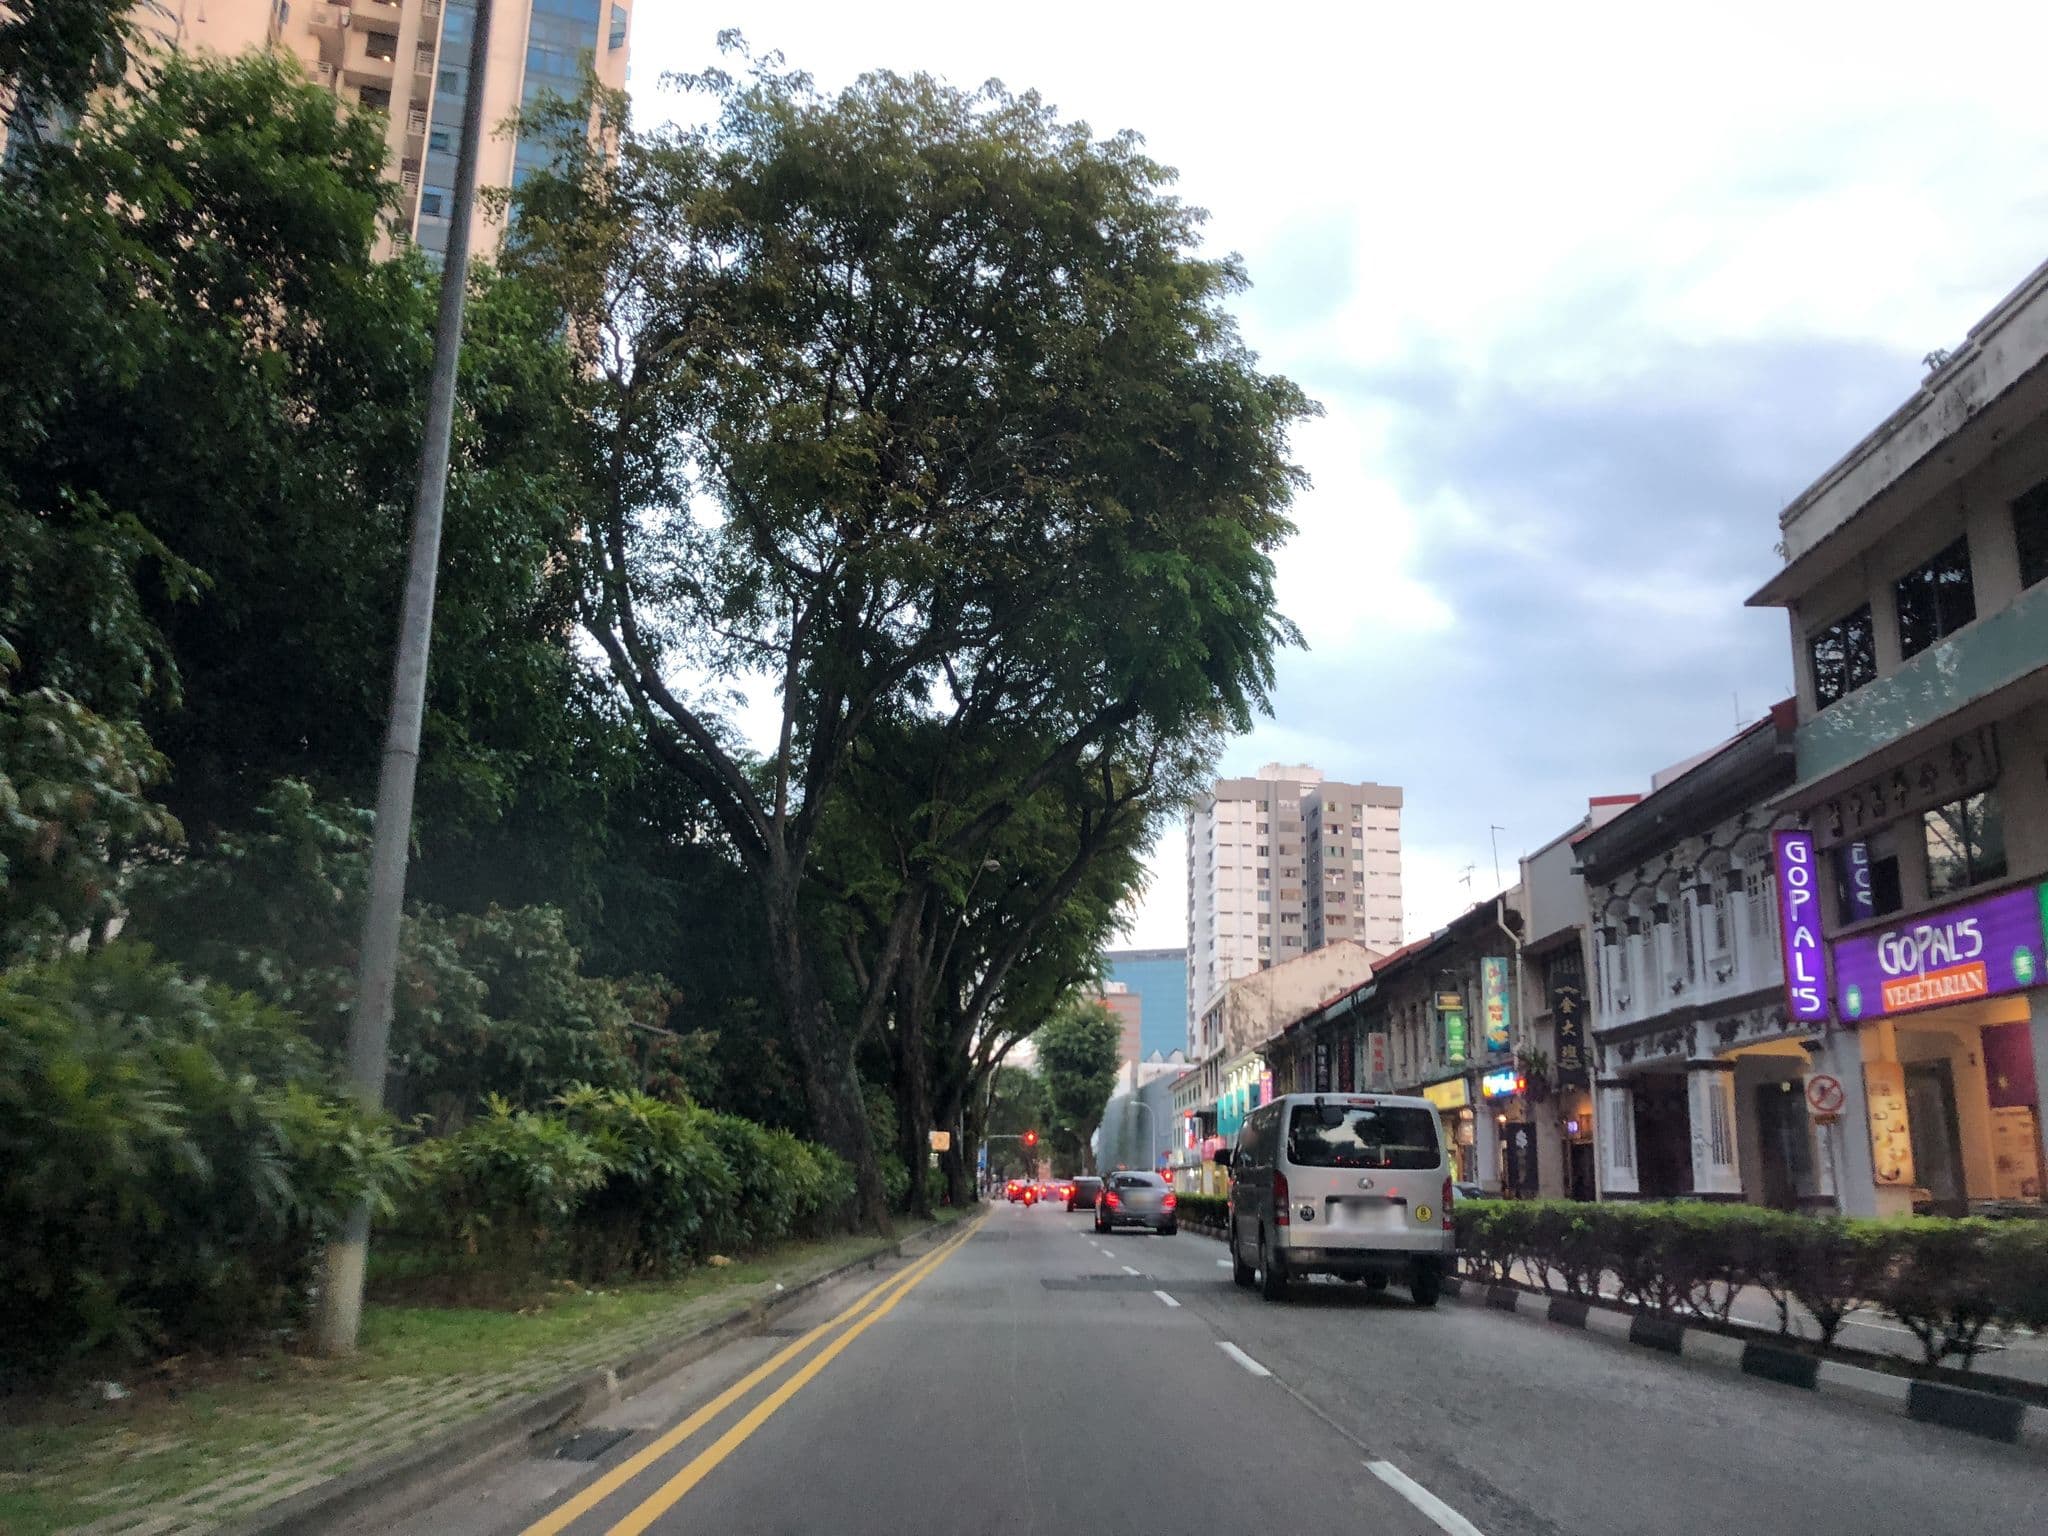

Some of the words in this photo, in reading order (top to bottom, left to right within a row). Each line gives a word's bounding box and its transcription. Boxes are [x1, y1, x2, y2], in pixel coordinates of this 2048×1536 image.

[1785, 841, 1821, 1012] GOPAL'S
[1878, 918, 1983, 982] GOPAL'S
[1885, 969, 1984, 1006] VEGETARIAN
